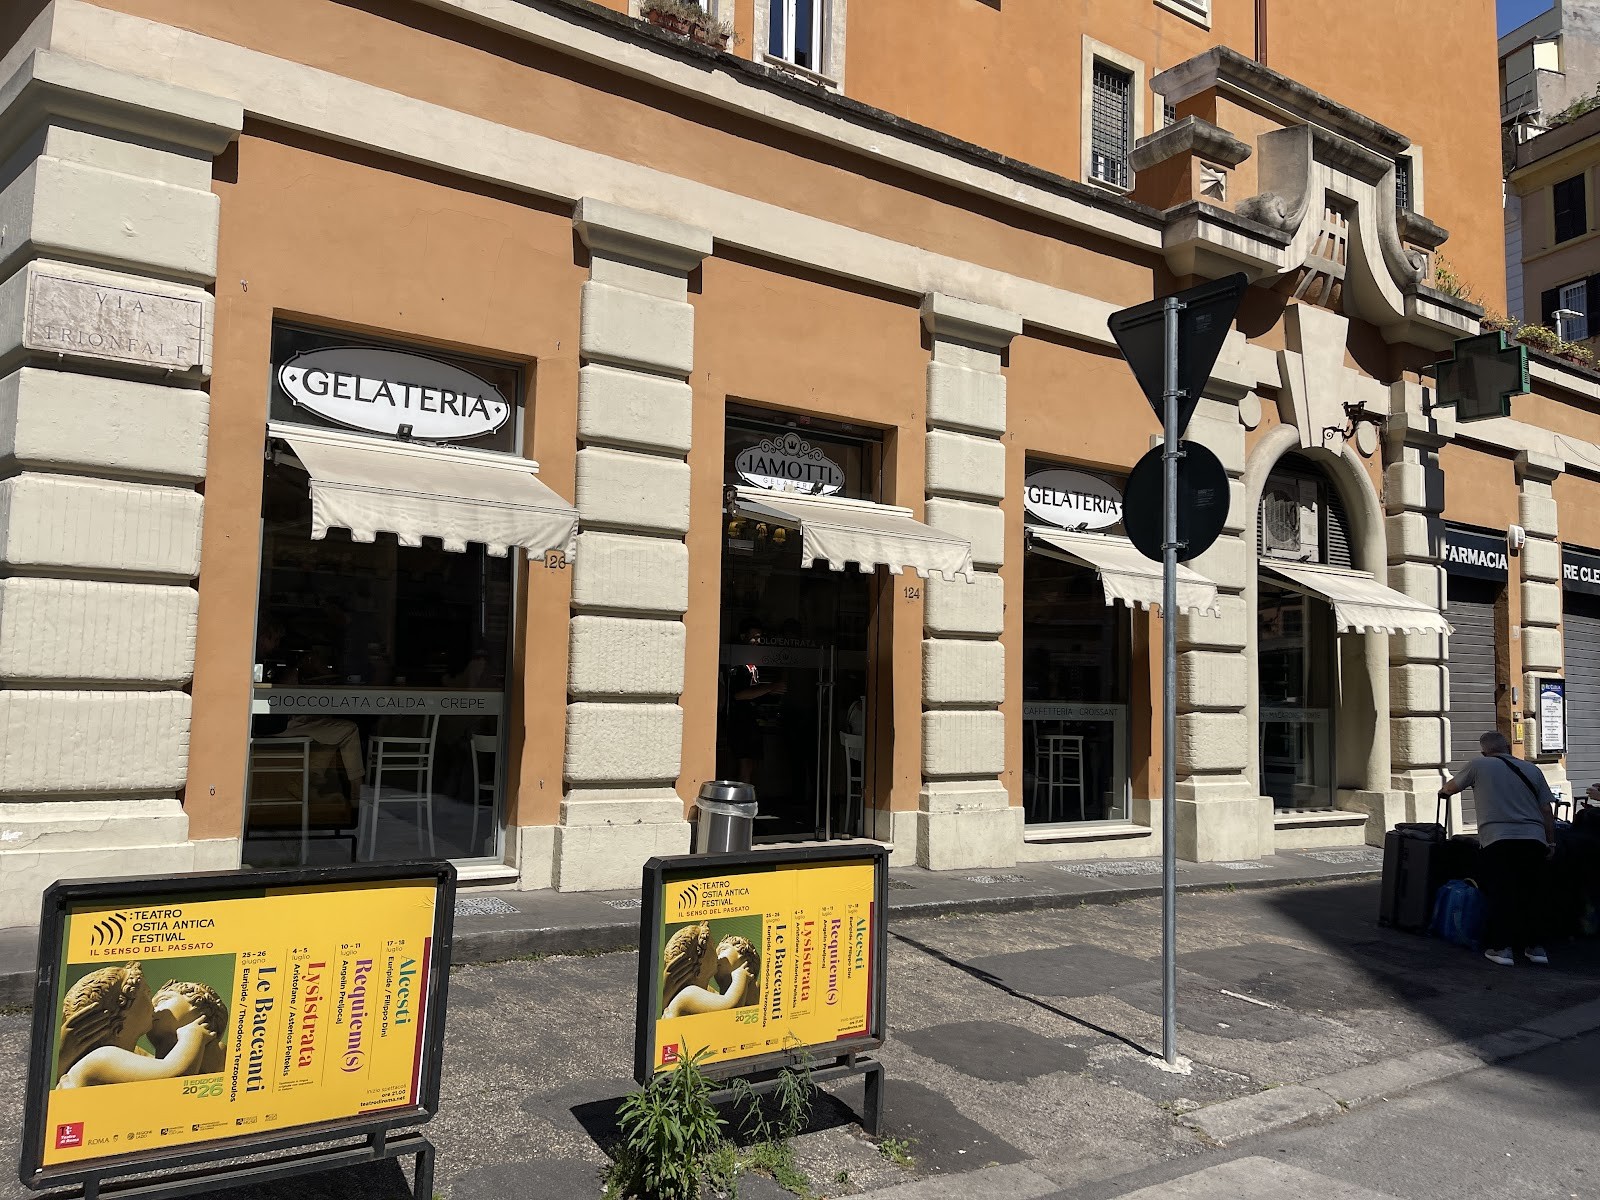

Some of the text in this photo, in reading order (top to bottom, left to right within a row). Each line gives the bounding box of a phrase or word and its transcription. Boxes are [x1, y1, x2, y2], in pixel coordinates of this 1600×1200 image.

[96, 292, 145, 313] VIA
[44, 325, 188, 359] TRIONFALE
[302, 367, 491, 421] GELATERIA
[748, 454, 832, 484] IAMOTTI
[763, 477, 812, 489] GELATERI
[1028, 484, 1118, 515] GELATERIA
[544, 555, 566, 569] 126
[1445, 544, 1508, 570] FARMACIA
[1563, 564, 1579, 581] RE
[904, 586, 920, 599] 124
[267, 695, 485, 709] CIOCCOLATA CALDA CREPE
[1024, 707, 1118, 716] CAFFETTERIA CROISSANT
[702, 887, 750, 899] OSTIA ANTICA
[702, 898, 733, 908] FESTIVAL
[686, 909, 708, 917] SENSO
[723, 905, 750, 913] PASSATO
[131, 932, 186, 944] FESTIVAL
[132, 918, 215, 932] OSTIA ANTICA
[104, 946, 141, 955] SENSO
[144, 945, 164, 953] DEL
[168, 942, 214, 951] PASSATO
[855, 915, 866, 970] Alcesti
[385, 956, 395, 988] Euripide
[771, 924, 787, 1020] Le Baccanti
[801, 920, 815, 1002] Lysistrata
[825, 918, 841, 1006] Requiem(s)
[240, 967, 250, 1002] Euripide
[257, 966, 277, 992] Le
[291, 963, 301, 1004] Aristofane
[339, 960, 349, 990] Angelin
[395, 955, 417, 1025] Alcesti
[298, 961, 327, 1069] Lysistrata
[340, 958, 373, 1073] Requiem(s)
[382, 994, 391, 1021] Filippo
[735, 1012, 760, 1024] 2026
[236, 1009, 246, 1052] Theodoros
[286, 1012, 296, 1045] Asterios
[380, 1022, 388, 1038] Dini
[246, 997, 275, 1094] Baccanti
[182, 1084, 224, 1099] 2026
[230, 1053, 242, 1103] Terzopoulos
[88, 1137, 110, 1146] ROMA
